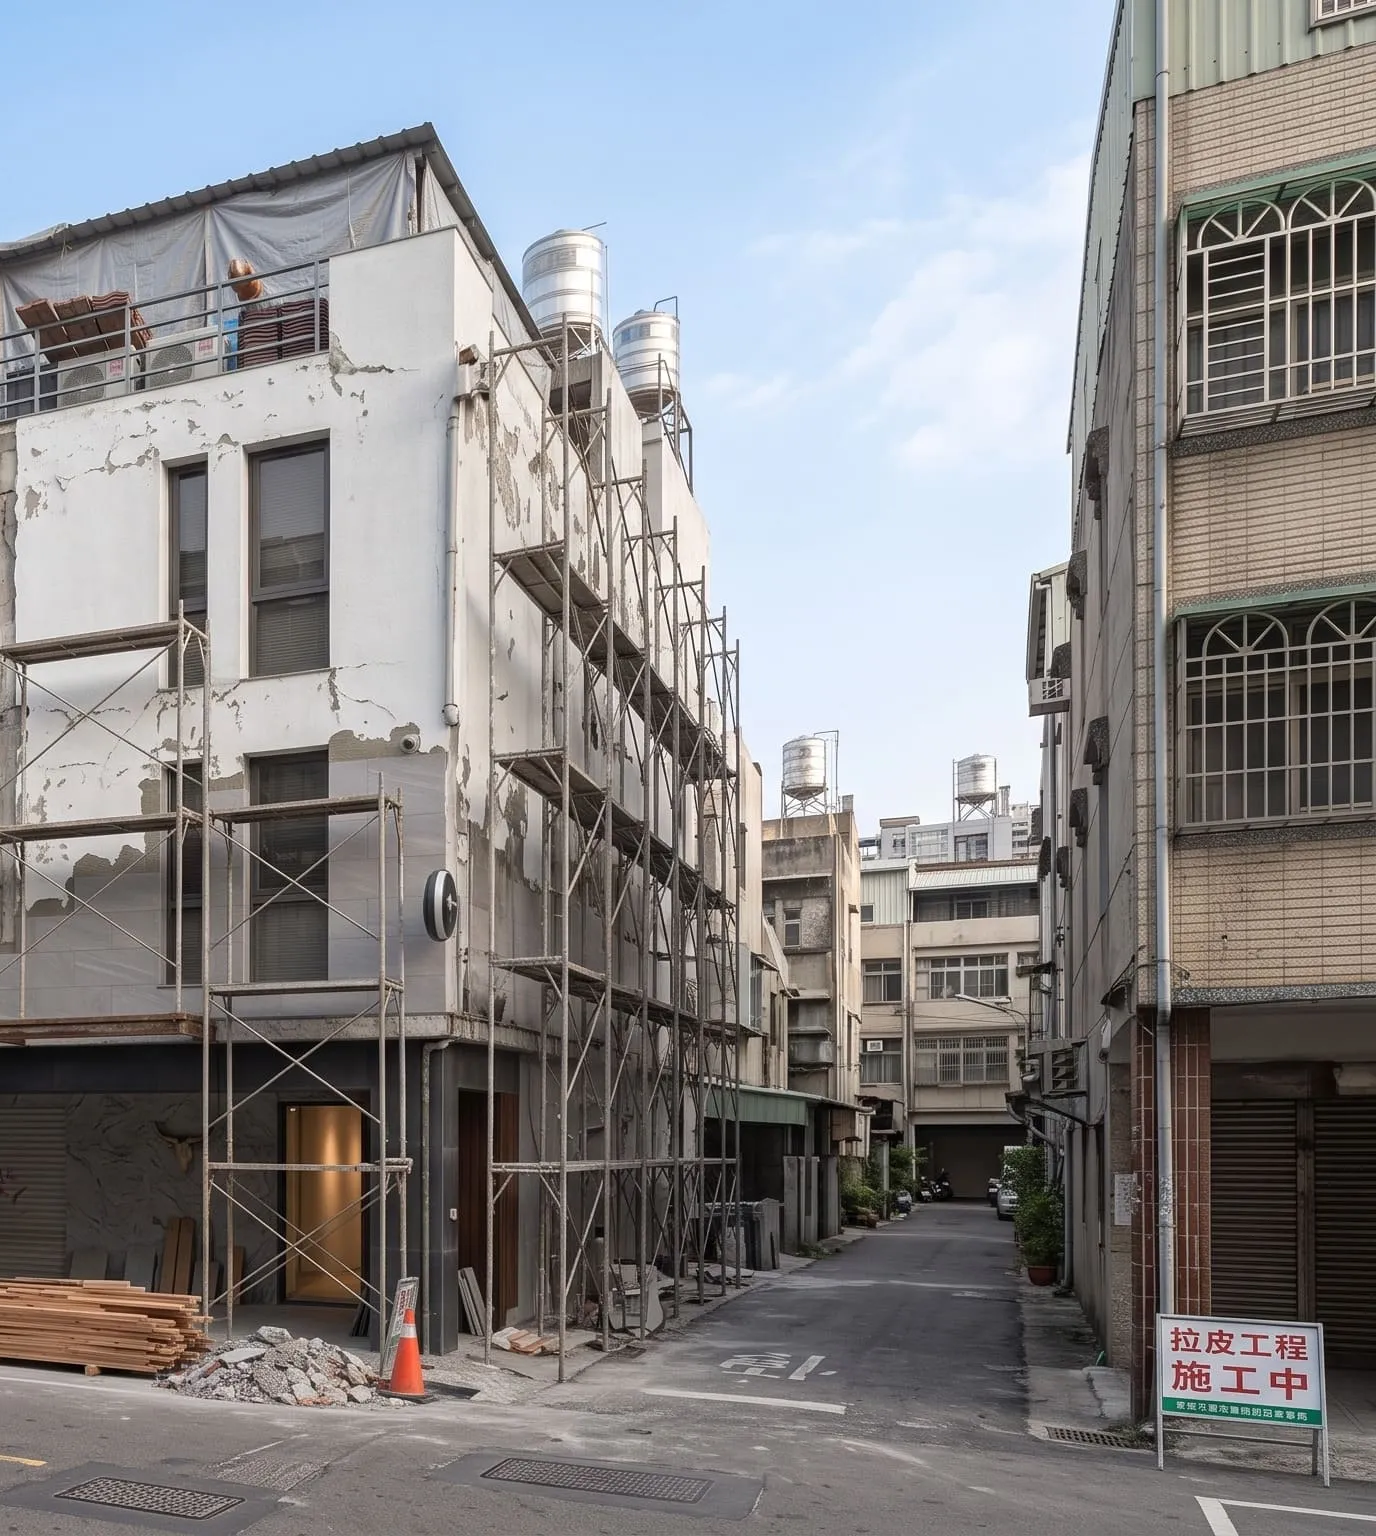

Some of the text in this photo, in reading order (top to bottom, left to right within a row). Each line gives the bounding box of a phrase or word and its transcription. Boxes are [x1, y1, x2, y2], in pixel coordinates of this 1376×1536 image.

[1170, 1327, 1309, 1361] 拉皮工程
[1171, 1359, 1308, 1401] 施工中
